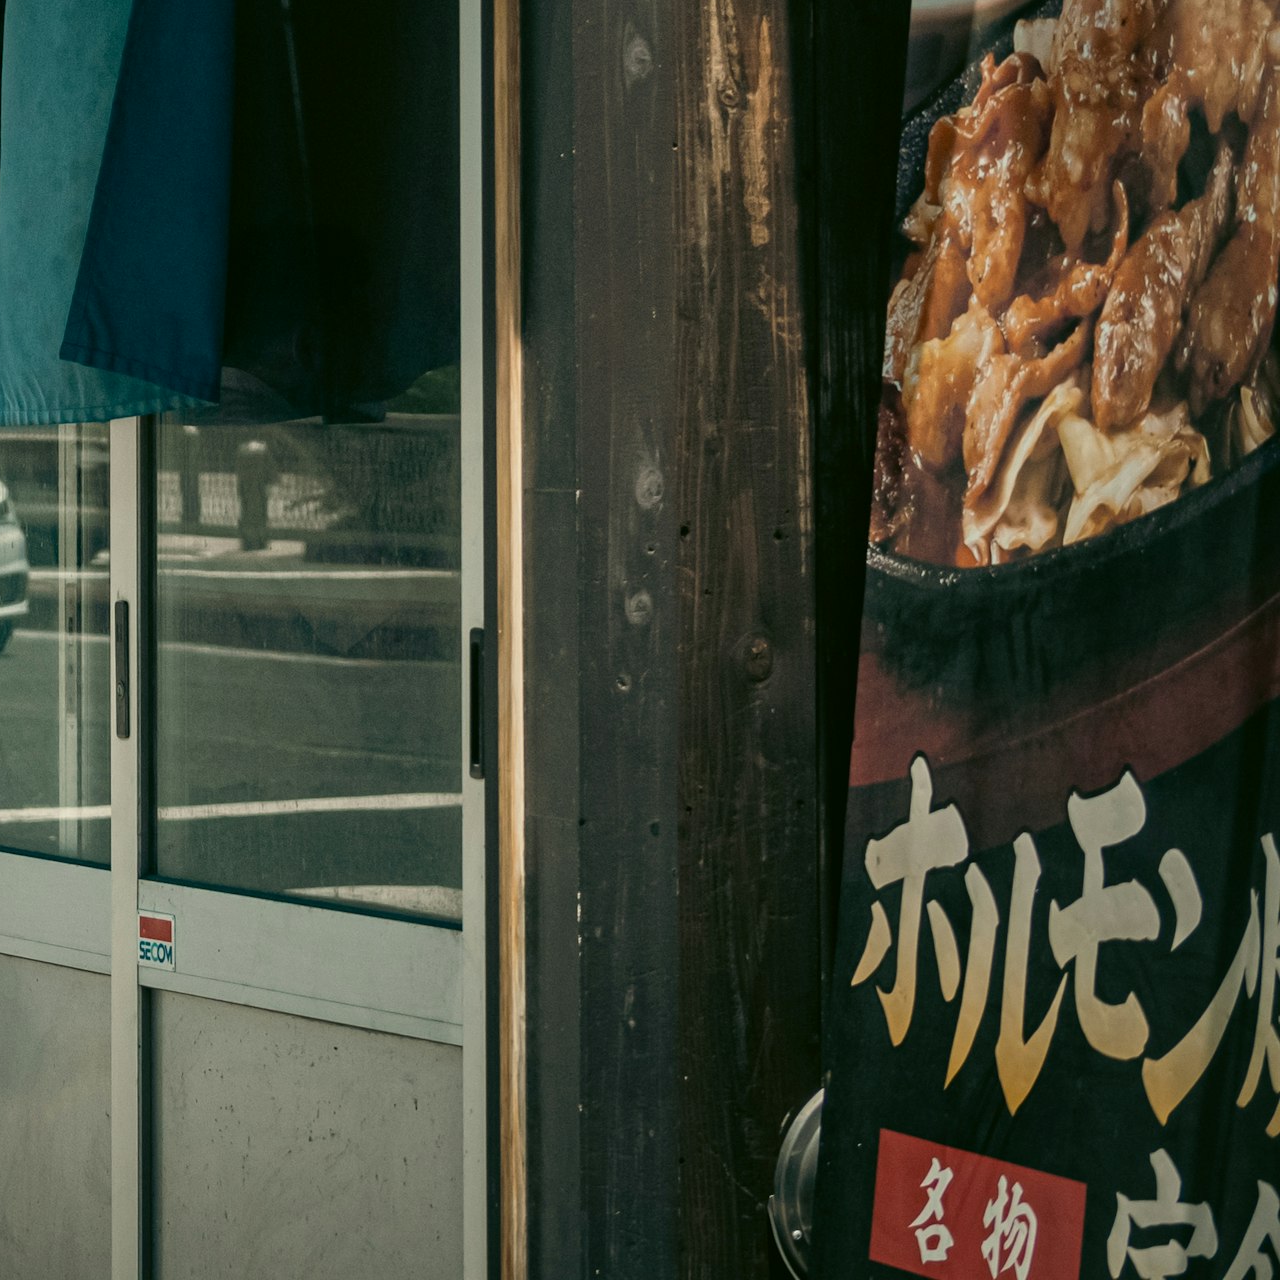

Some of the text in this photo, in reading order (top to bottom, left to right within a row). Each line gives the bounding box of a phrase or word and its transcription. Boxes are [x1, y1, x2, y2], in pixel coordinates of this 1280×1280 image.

[139, 940, 173, 965] SECOM
[850, 755, 1280, 1139] ホルモン
[908, 1156, 1038, 1280] 名物
